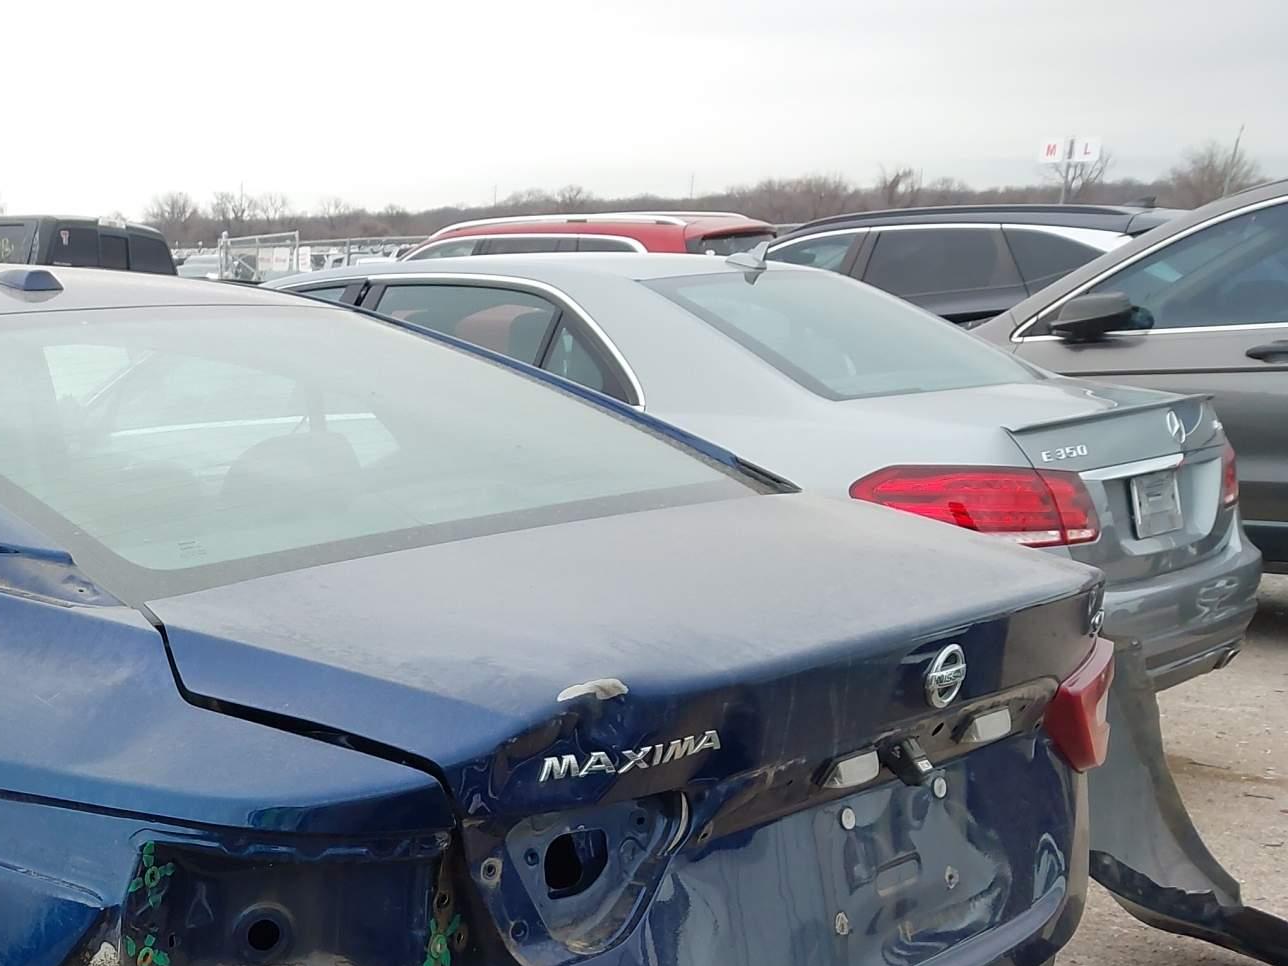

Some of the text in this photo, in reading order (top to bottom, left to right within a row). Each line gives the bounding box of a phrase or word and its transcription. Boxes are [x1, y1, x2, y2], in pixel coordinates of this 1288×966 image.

[1045, 143, 1057, 158] M
[1083, 142, 1092, 156] L
[1041, 444, 1088, 462] E 350
[539, 729, 722, 783] MAXIMA
